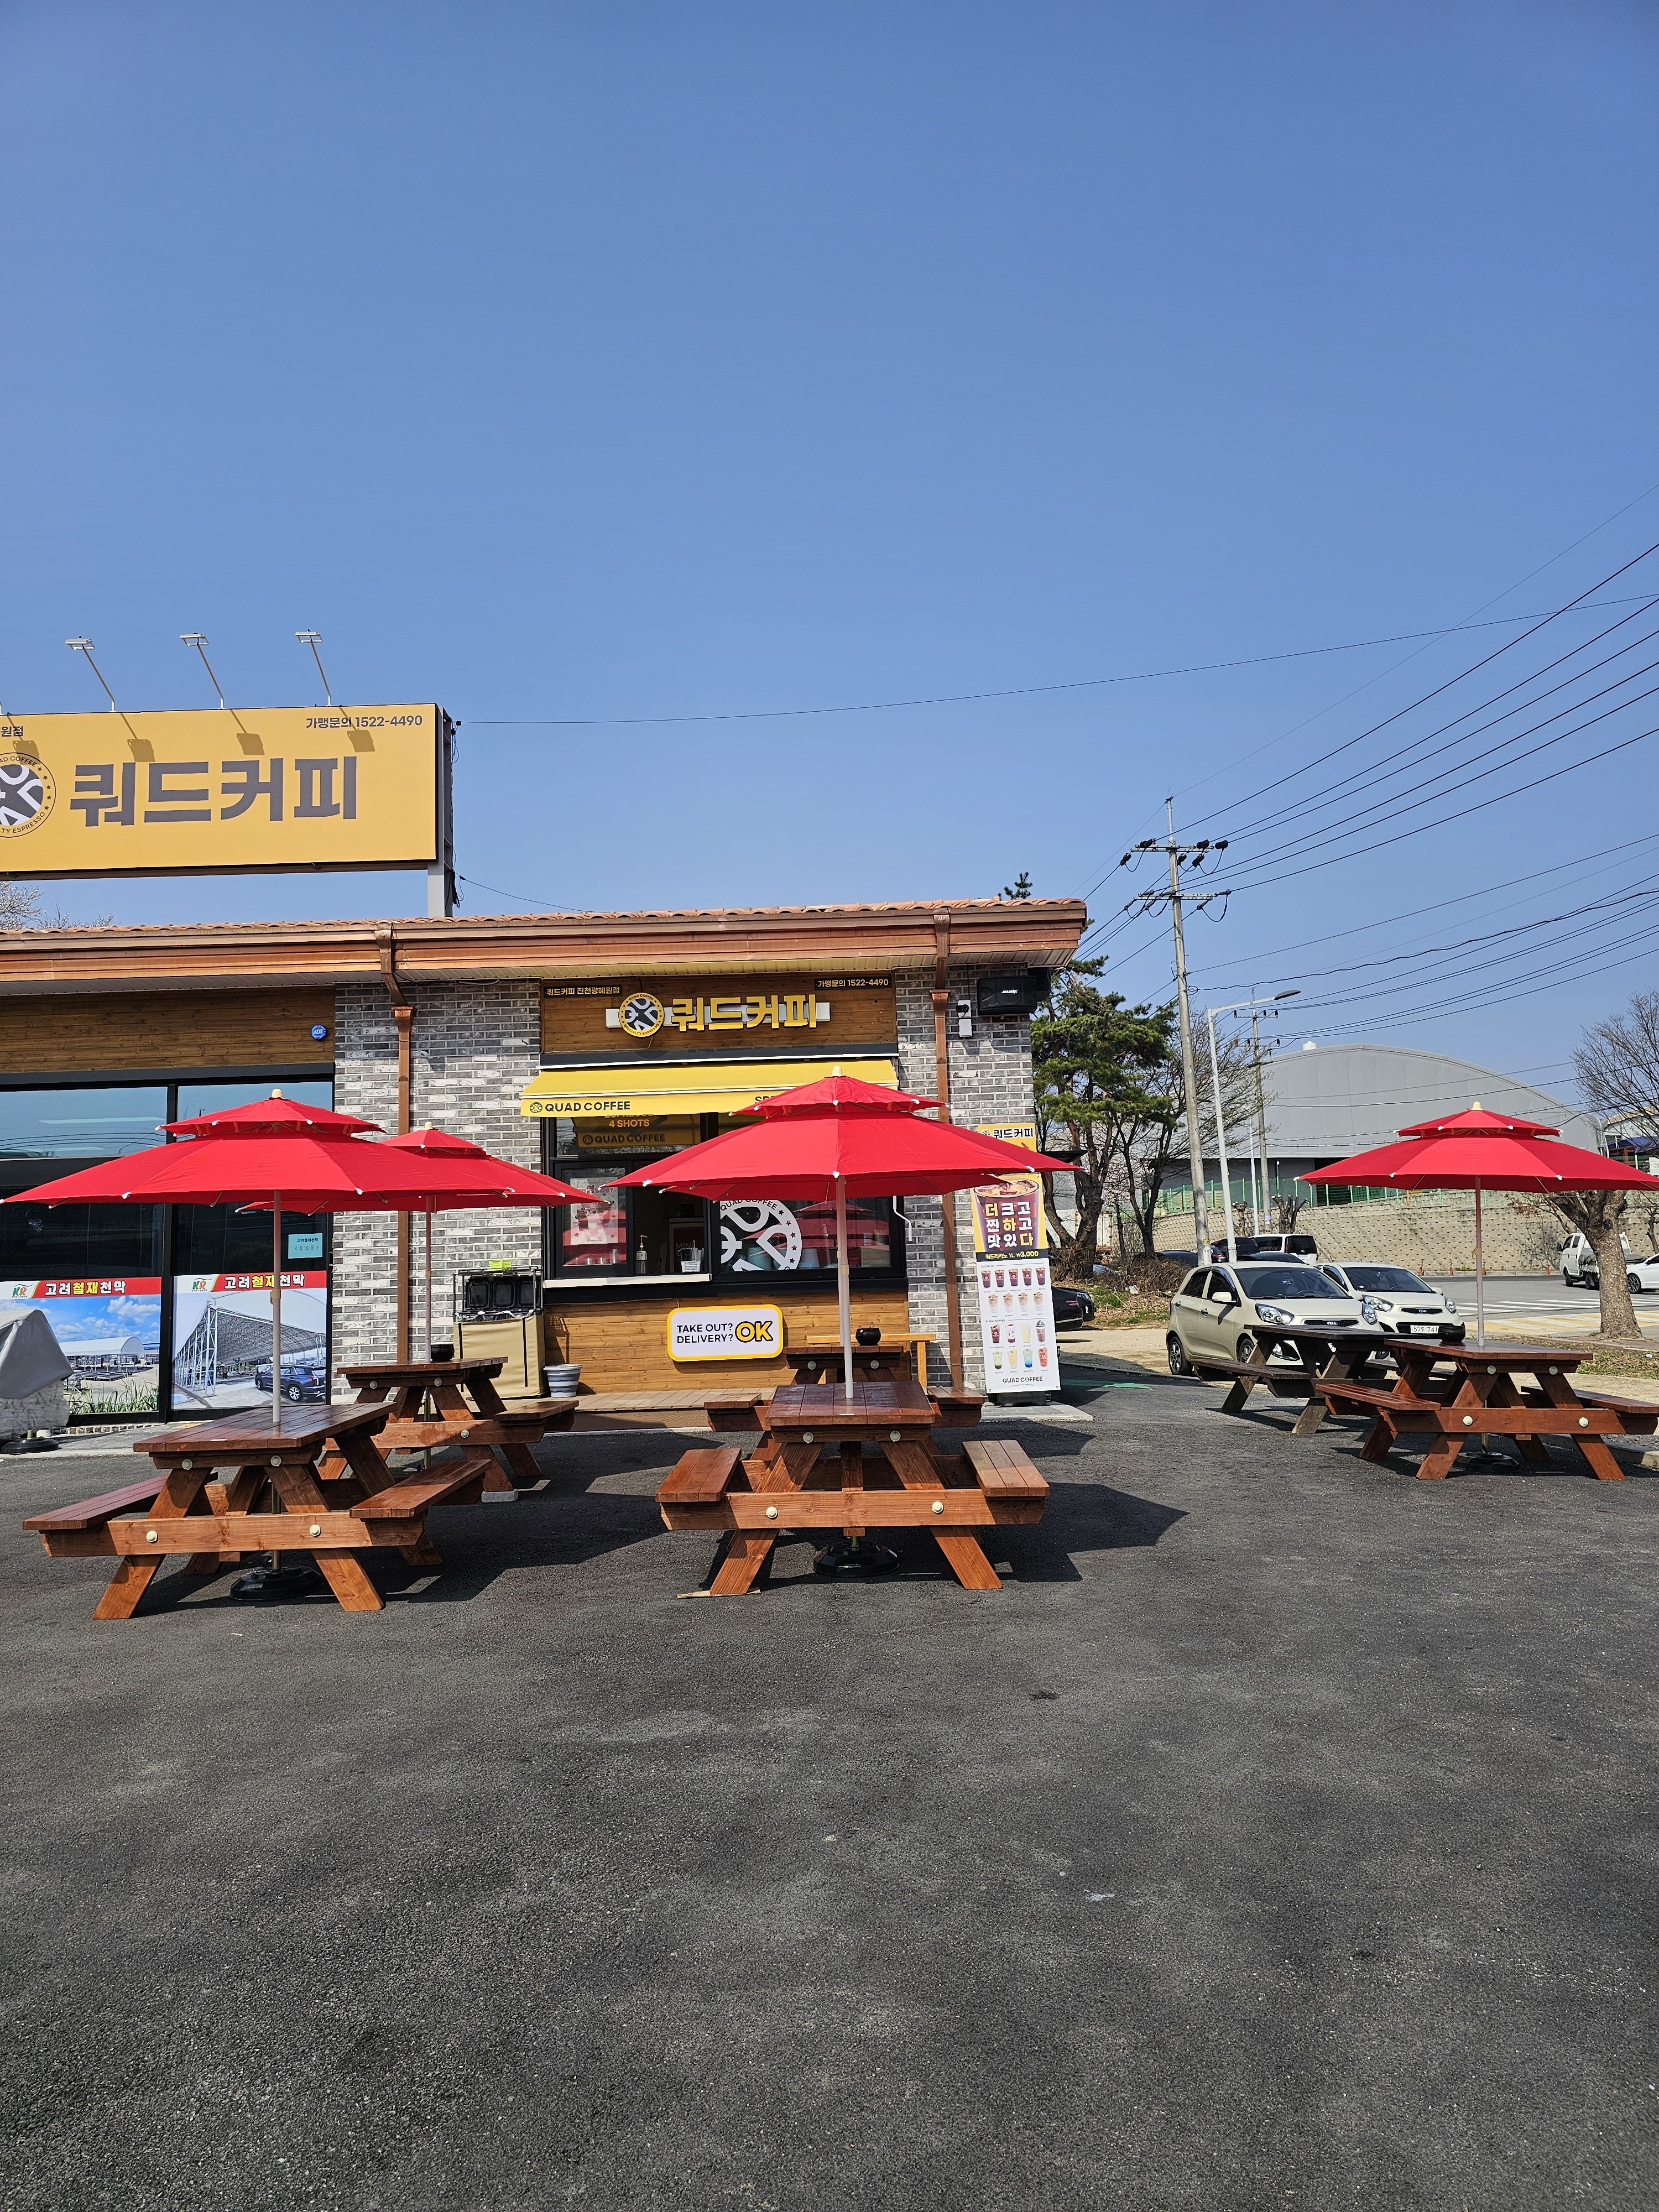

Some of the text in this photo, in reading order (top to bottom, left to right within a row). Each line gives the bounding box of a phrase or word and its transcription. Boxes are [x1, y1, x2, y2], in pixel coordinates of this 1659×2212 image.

[306, 715, 422, 728] 가맹문의 1522-4490
[10, 756, 37, 768] COFFEE
[70, 756, 357, 827] 쿼드커피
[13, 812, 45, 834] ESPRESSO
[817, 978, 889, 988] 가맹문의 1522-4490
[546, 987, 575, 996] 쿼드커피
[671, 994, 817, 1032] 쿼드커피
[545, 1101, 630, 1112] QUAD COFFEE
[993, 1128, 1034, 1138] 쿼드커피
[594, 1134, 665, 1144] QUAD COFFEE
[987, 1233, 1034, 1249] 맛있다
[45, 1280, 127, 1296] 고려철재천막
[192, 1280, 207, 1290] KR
[12, 1287, 27, 1296] KR
[676, 1323, 733, 1333] TAKE OUT?
[735, 1321, 774, 1343] OK
[677, 1334, 733, 1343] DELIVERY?
